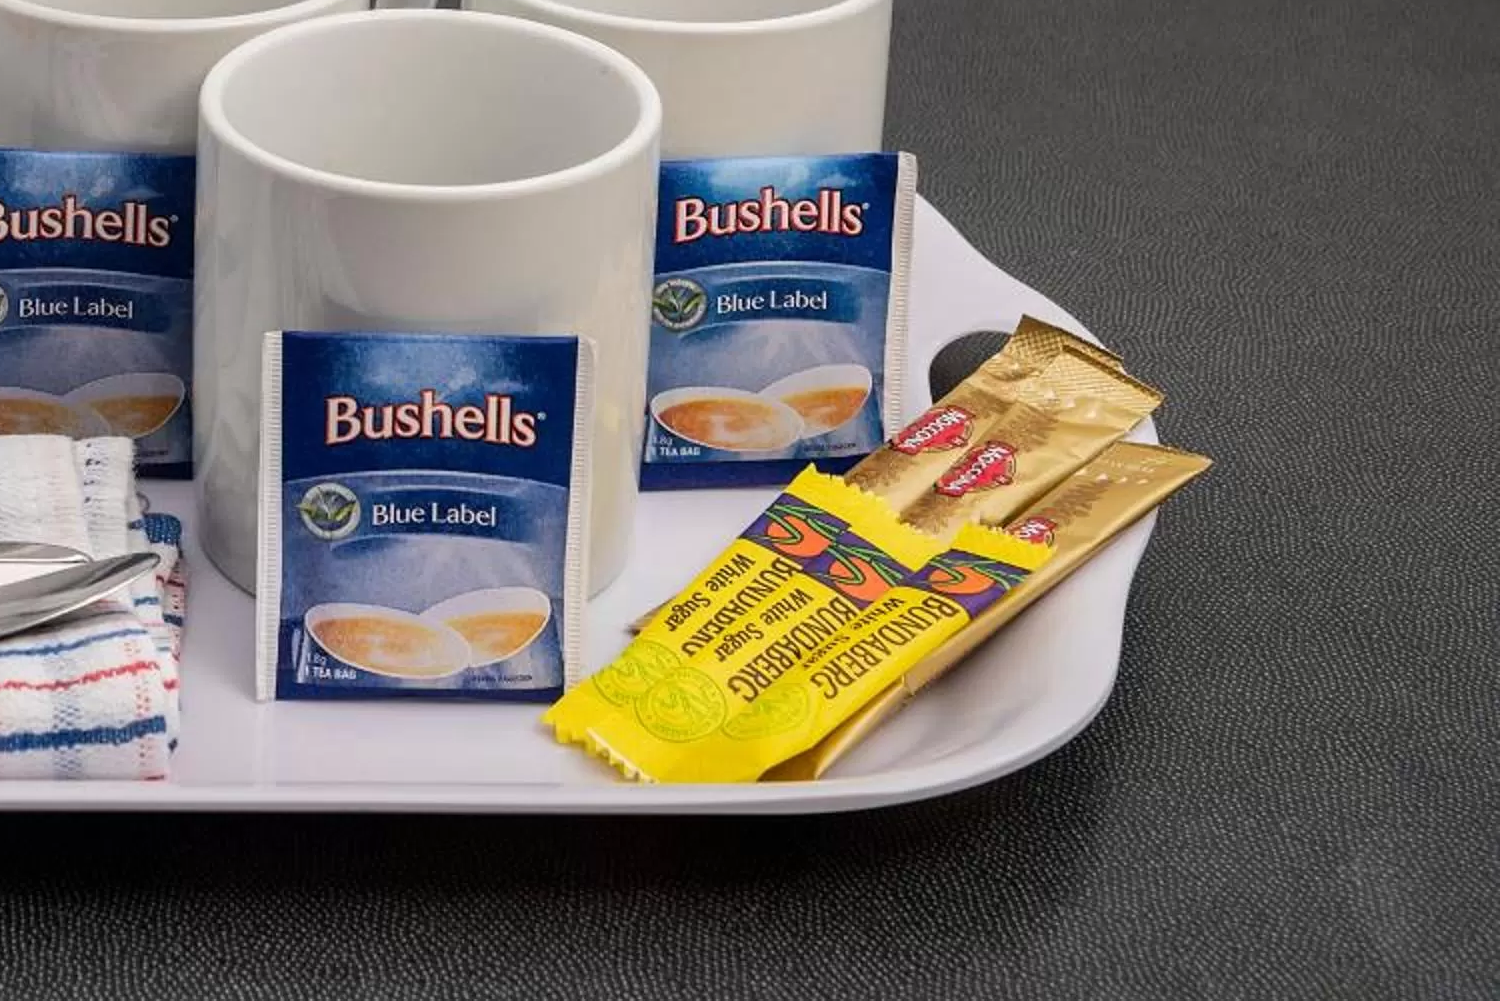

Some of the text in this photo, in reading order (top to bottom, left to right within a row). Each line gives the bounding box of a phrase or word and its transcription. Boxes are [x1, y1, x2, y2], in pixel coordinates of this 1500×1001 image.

[673, 185, 865, 245] Bushells
[19, 296, 133, 319] Blue Label
[717, 293, 765, 314] Blue
[769, 291, 827, 311] Label
[324, 388, 537, 447] Bushells
[372, 502, 497, 527] Blue Label
[664, 552, 756, 632] White Sugar
[851, 597, 905, 631] White
[713, 587, 814, 662] White Sugar
[727, 595, 864, 703] BUNDABERG
[810, 594, 961, 699] BUNDABERG
